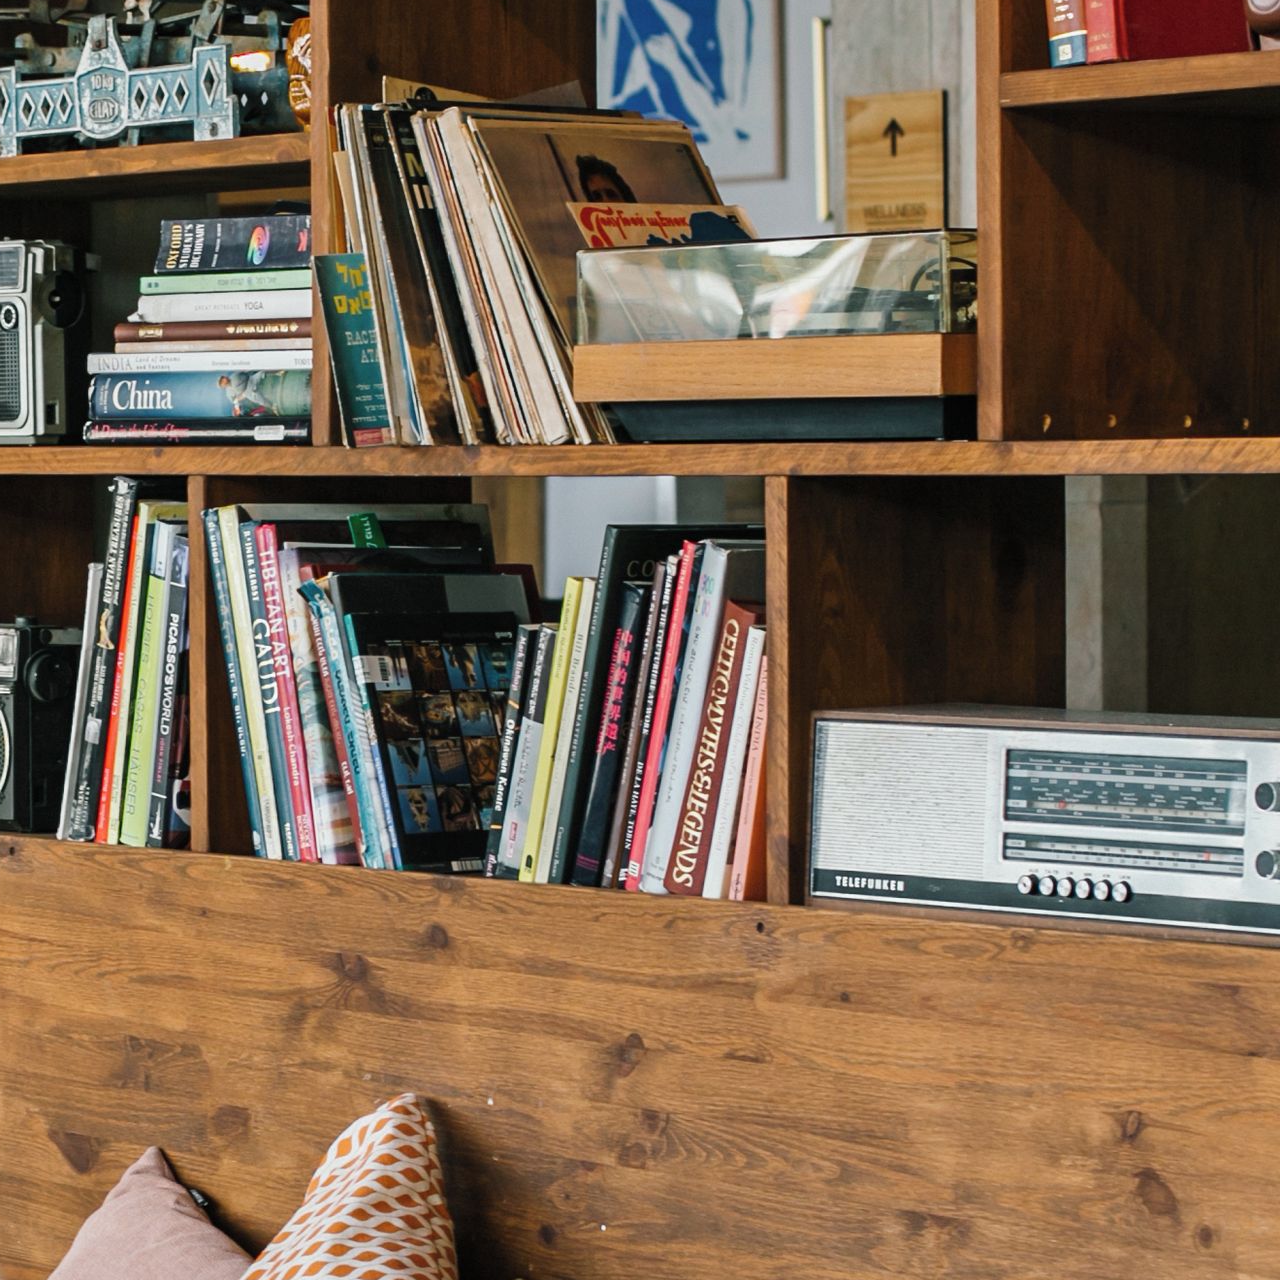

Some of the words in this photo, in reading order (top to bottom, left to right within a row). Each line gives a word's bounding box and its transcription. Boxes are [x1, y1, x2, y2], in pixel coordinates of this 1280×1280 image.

[864, 204, 927, 220] WELLNESS
[165, 224, 182, 269] OXFORD
[178, 224, 194, 269] STUDENT'S
[189, 223, 205, 268] DICTIONARY
[336, 262, 368, 288] חל
[244, 301, 263, 310] YOGA
[345, 332, 377, 345] RACH
[360, 349, 380, 363] ATA
[98, 358, 133, 371] INDIA
[113, 381, 173, 411] China
[103, 556, 115, 604] EGYPTIAN
[109, 494, 122, 556] TREASURES
[243, 529, 254, 566] RAINER
[248, 567, 259, 602] ZERBST
[142, 595, 154, 664] HOUSES
[259, 545, 284, 634] TIBETAN
[272, 638, 289, 680] ART
[658, 607, 669, 625] THE
[516, 635, 527, 658] Mark
[574, 633, 583, 653] Bill
[510, 659, 524, 691] Bishop
[567, 657, 580, 693] Brandt
[577, 670, 589, 711] WILLIAM
[133, 677, 146, 735] CASAS
[159, 685, 173, 735] WORLD
[641, 706, 652, 735] WORK
[283, 706, 294, 743] Lokesh
[750, 714, 764, 752] INDIA
[498, 718, 516, 775] Okinawan
[288, 743, 300, 786] Chandra
[632, 774, 642, 788] LA
[634, 760, 644, 774] DE
[493, 776, 507, 812] Karate
[284, 821, 293, 856] TASCHEN
[623, 819, 634, 850] TOBIN
[834, 875, 905, 892] TELEFUNKEN
